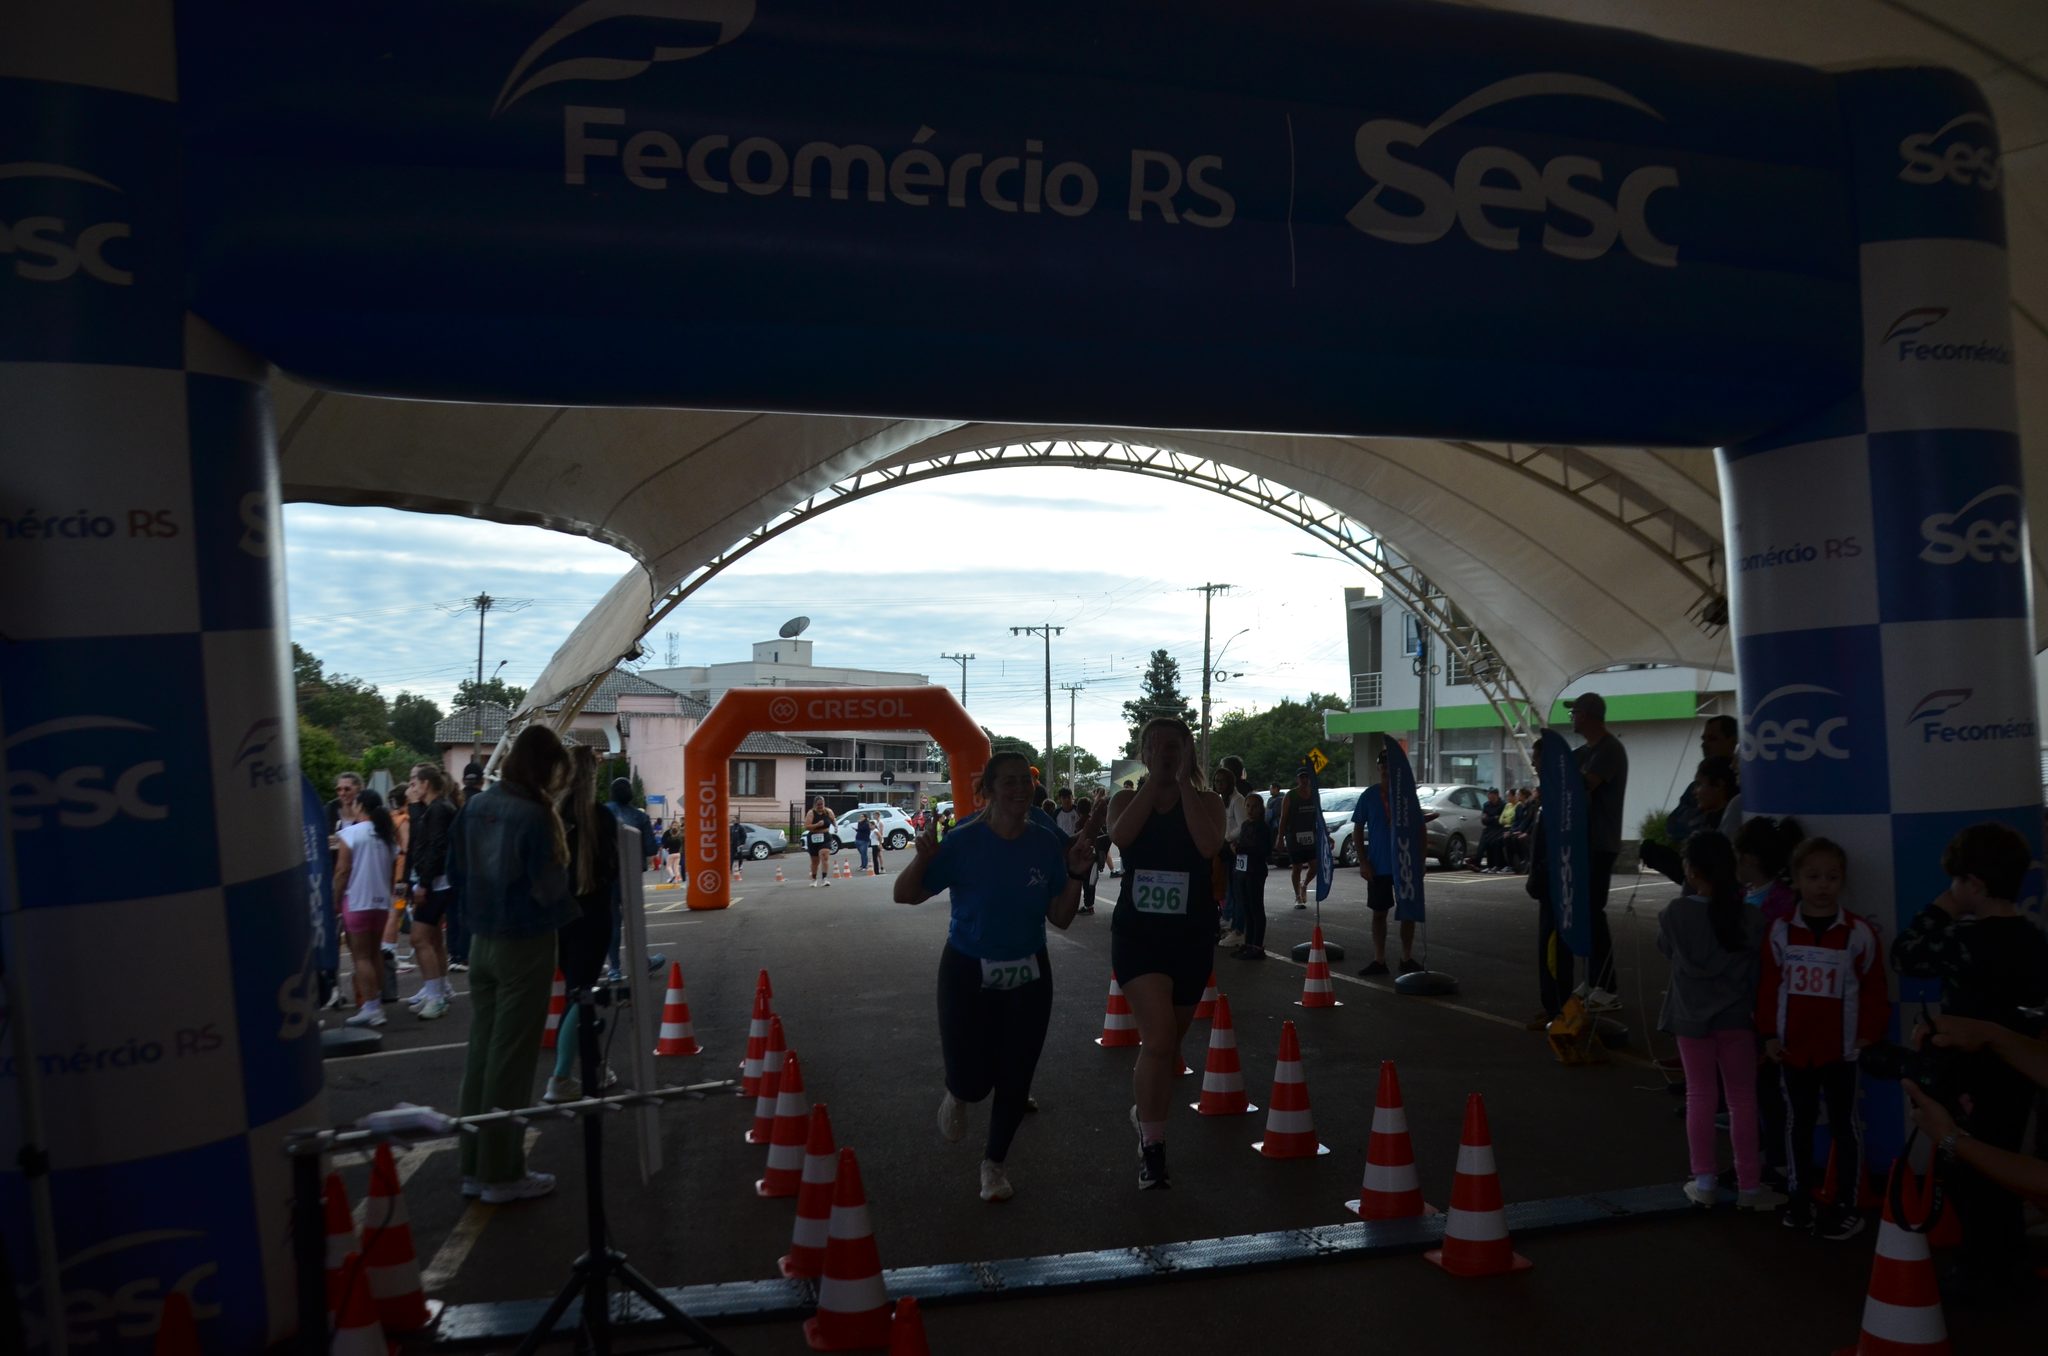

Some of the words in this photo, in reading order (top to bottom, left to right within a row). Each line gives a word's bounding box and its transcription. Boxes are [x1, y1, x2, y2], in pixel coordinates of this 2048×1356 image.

[563, 105, 1100, 218] Fecomércio
[1128, 148, 1237, 229] RS
[1896, 130, 1999, 191] Ses
[1345, 110, 1680, 269] Sesc
[127, 509, 180, 539] RS
[1918, 511, 2021, 566] Ses
[1824, 536, 1863, 560] RS
[807, 697, 912, 720] CRESOL
[8, 759, 170, 831] esc
[699, 773, 718, 863] CRESOL
[1397, 836, 1416, 902] Sesc
[1137, 885, 1180, 911] 296
[990, 965, 1033, 987] 279
[1785, 964, 1837, 994] 1381
[176, 1022, 223, 1058] RS
